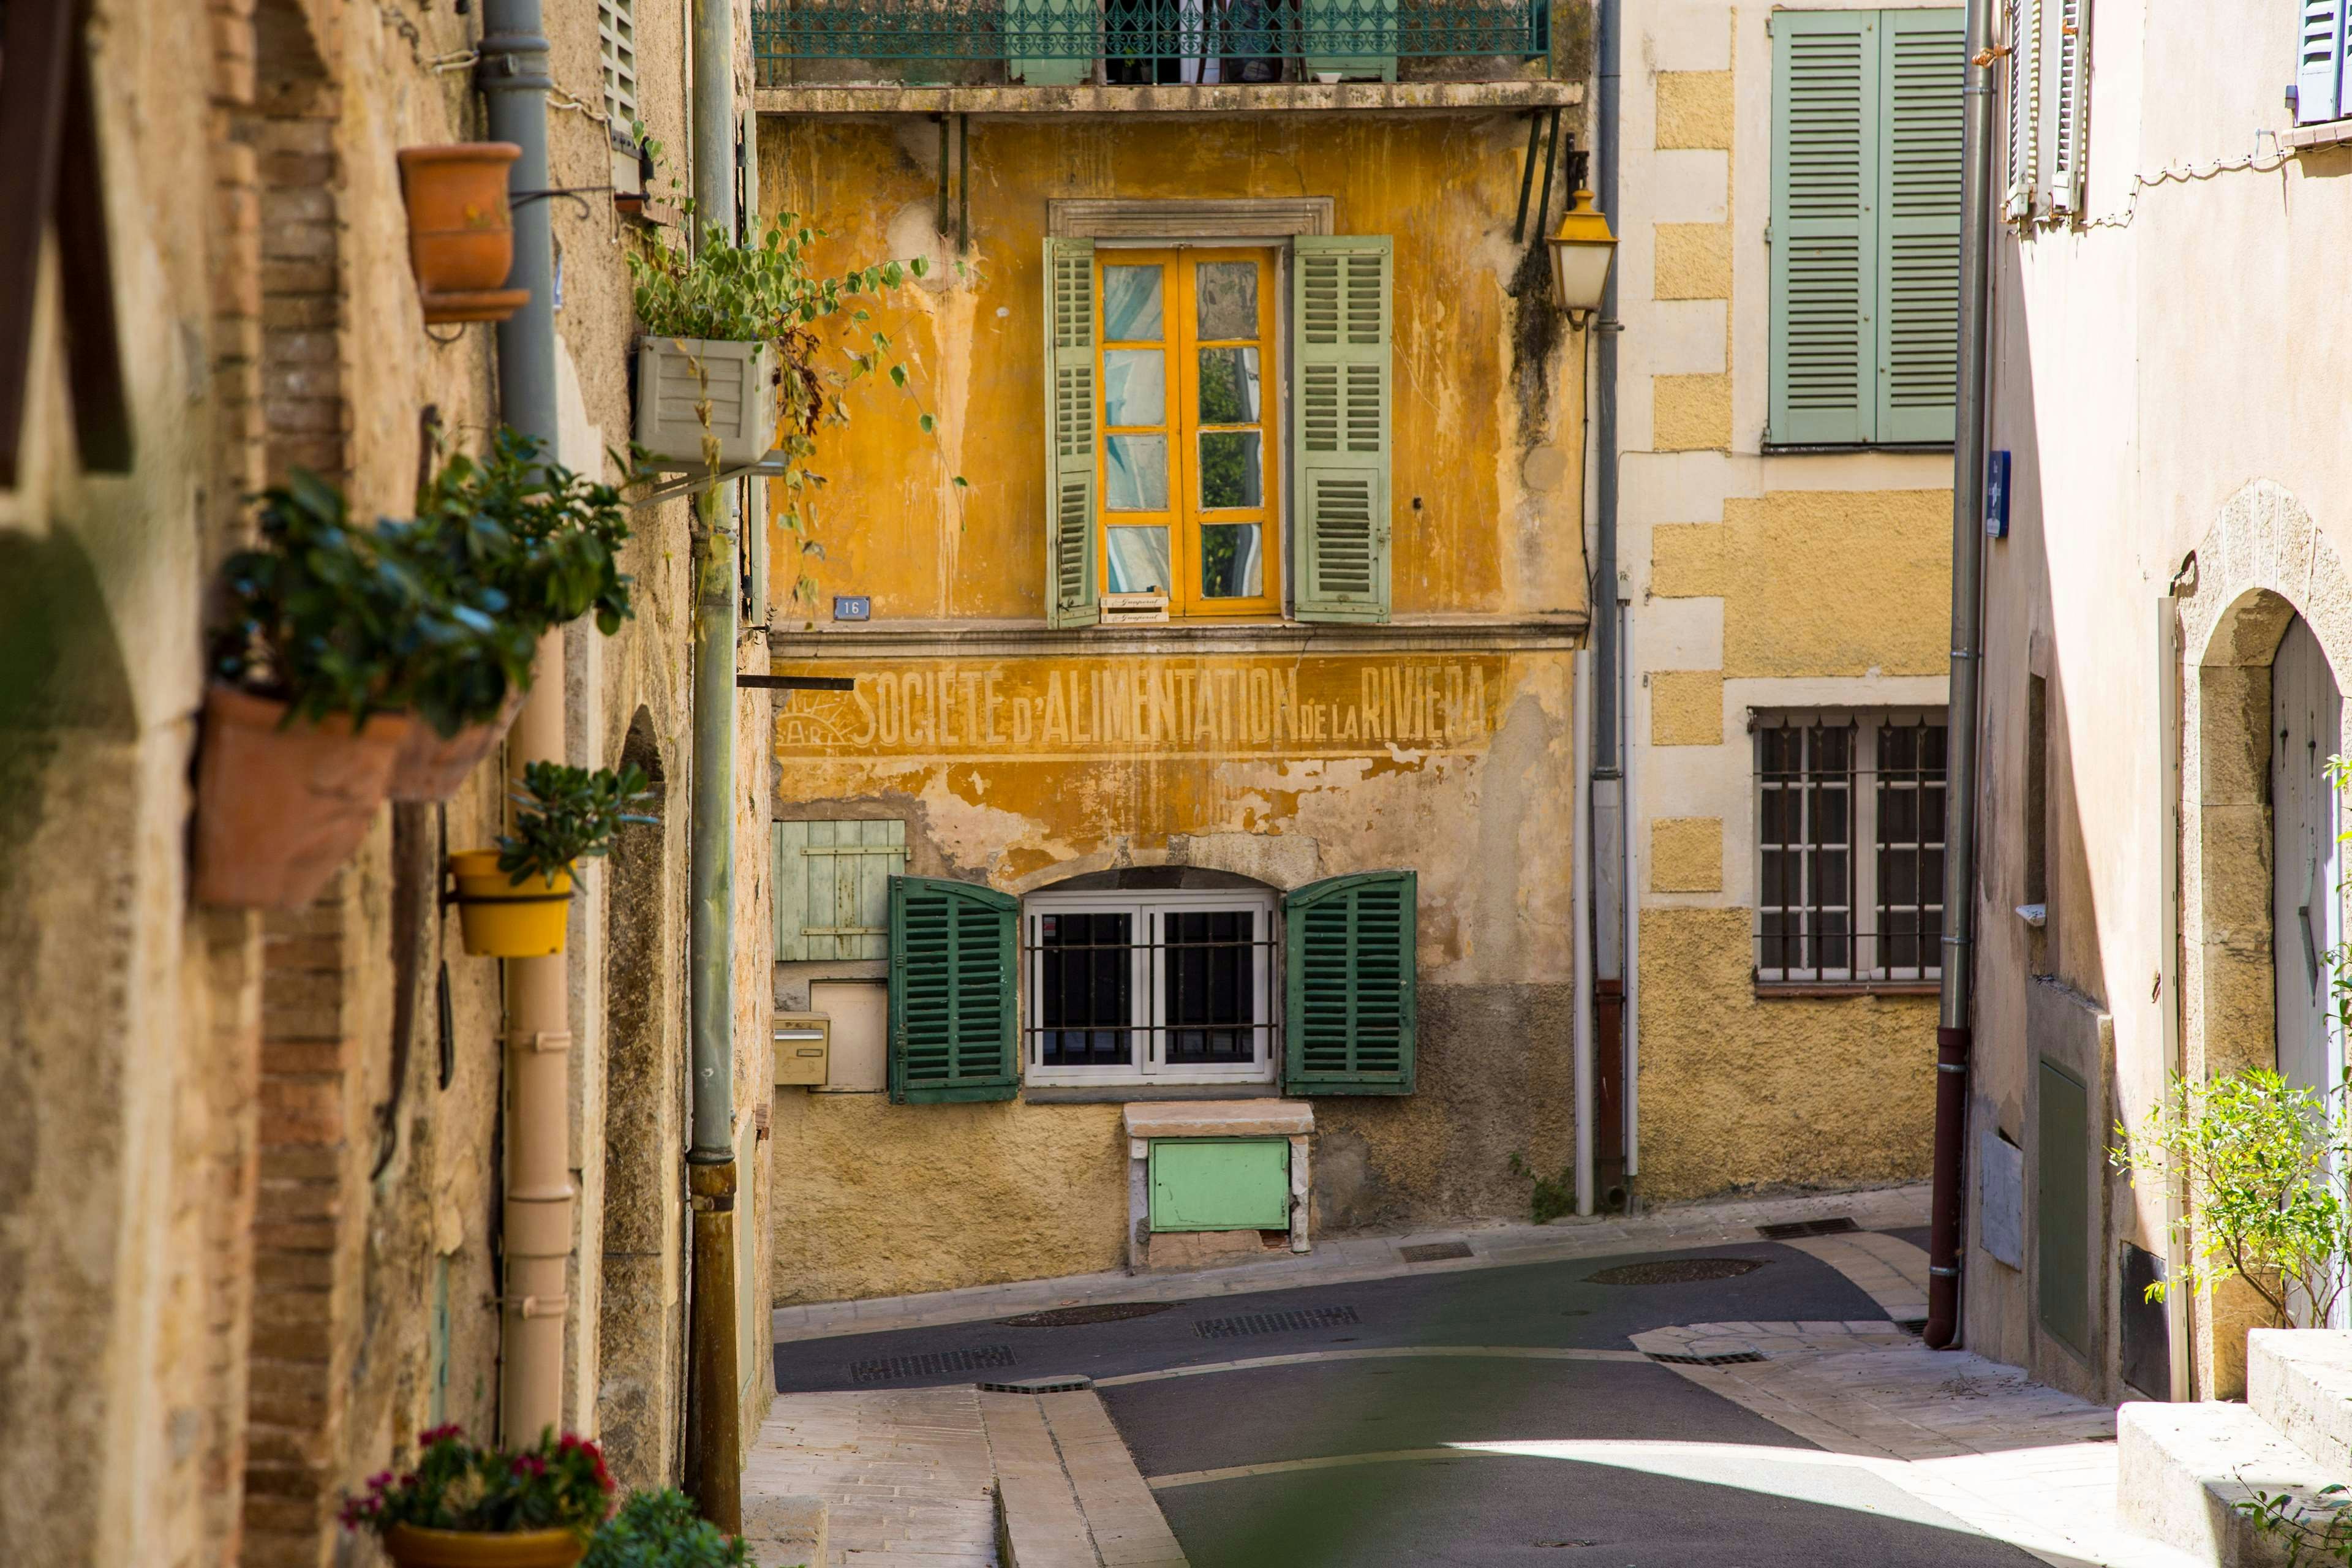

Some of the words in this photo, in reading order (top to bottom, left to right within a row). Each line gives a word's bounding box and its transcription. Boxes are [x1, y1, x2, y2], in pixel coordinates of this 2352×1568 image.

[845, 601, 859, 614] 16
[1300, 703, 1325, 740] DE
[1333, 704, 1359, 739] LA
